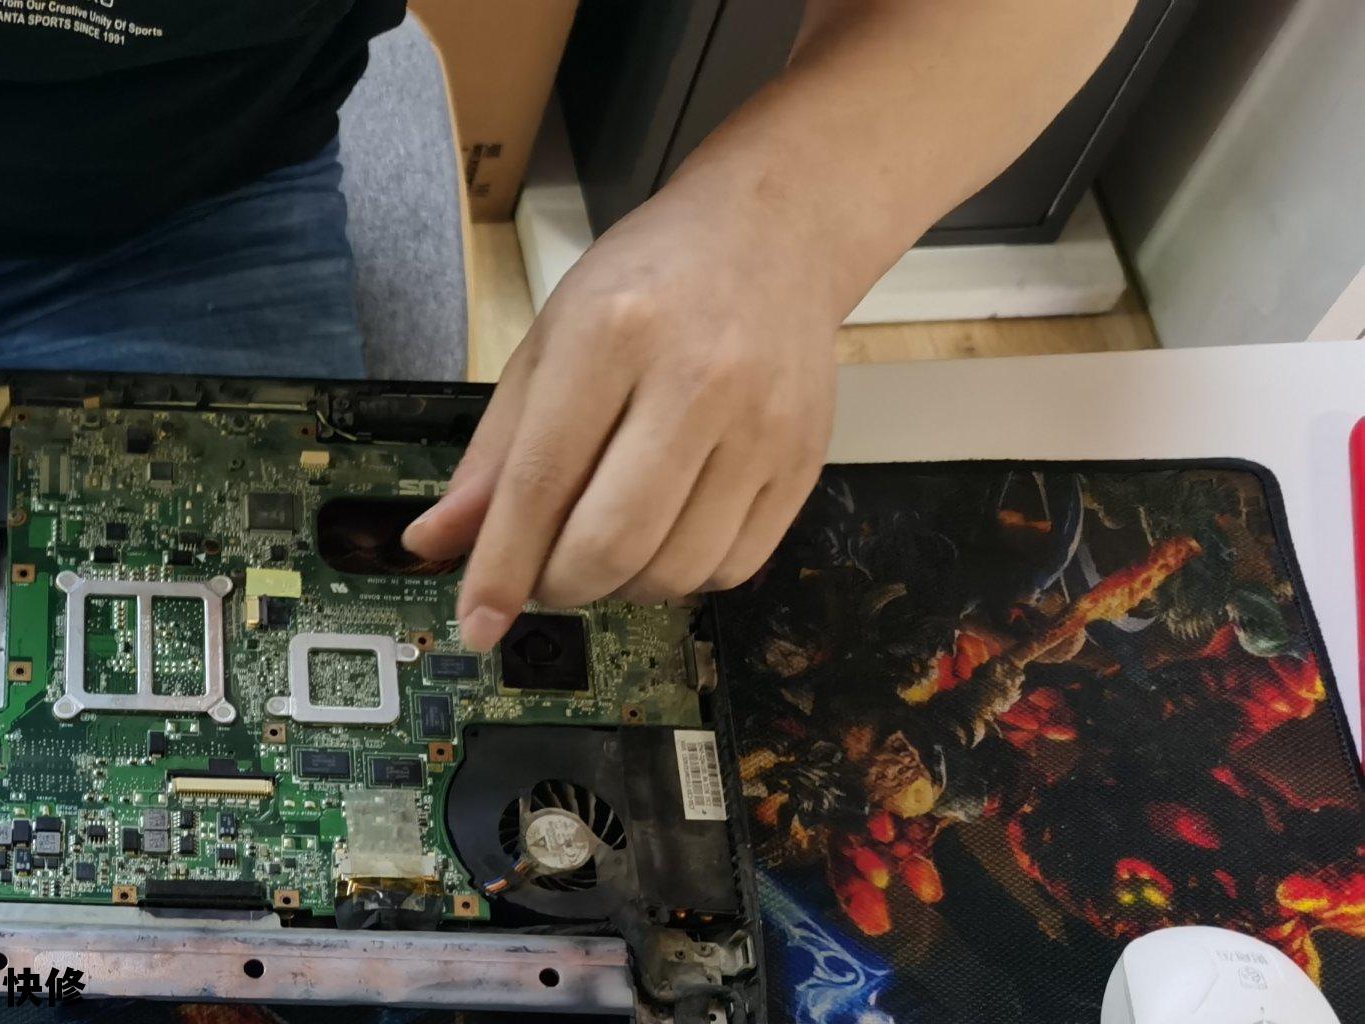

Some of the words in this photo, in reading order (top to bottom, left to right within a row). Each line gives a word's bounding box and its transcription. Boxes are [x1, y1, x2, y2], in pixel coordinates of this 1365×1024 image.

[26, 0, 46, 11] Our
[48, 1, 88, 19] Creative
[89, 10, 113, 30] Unity
[114, 19, 127, 31] Of
[128, 22, 163, 37] Sports
[28, 14, 72, 30] SPORTS
[73, 21, 100, 40] SINCE
[103, 31, 125, 46] 1991
